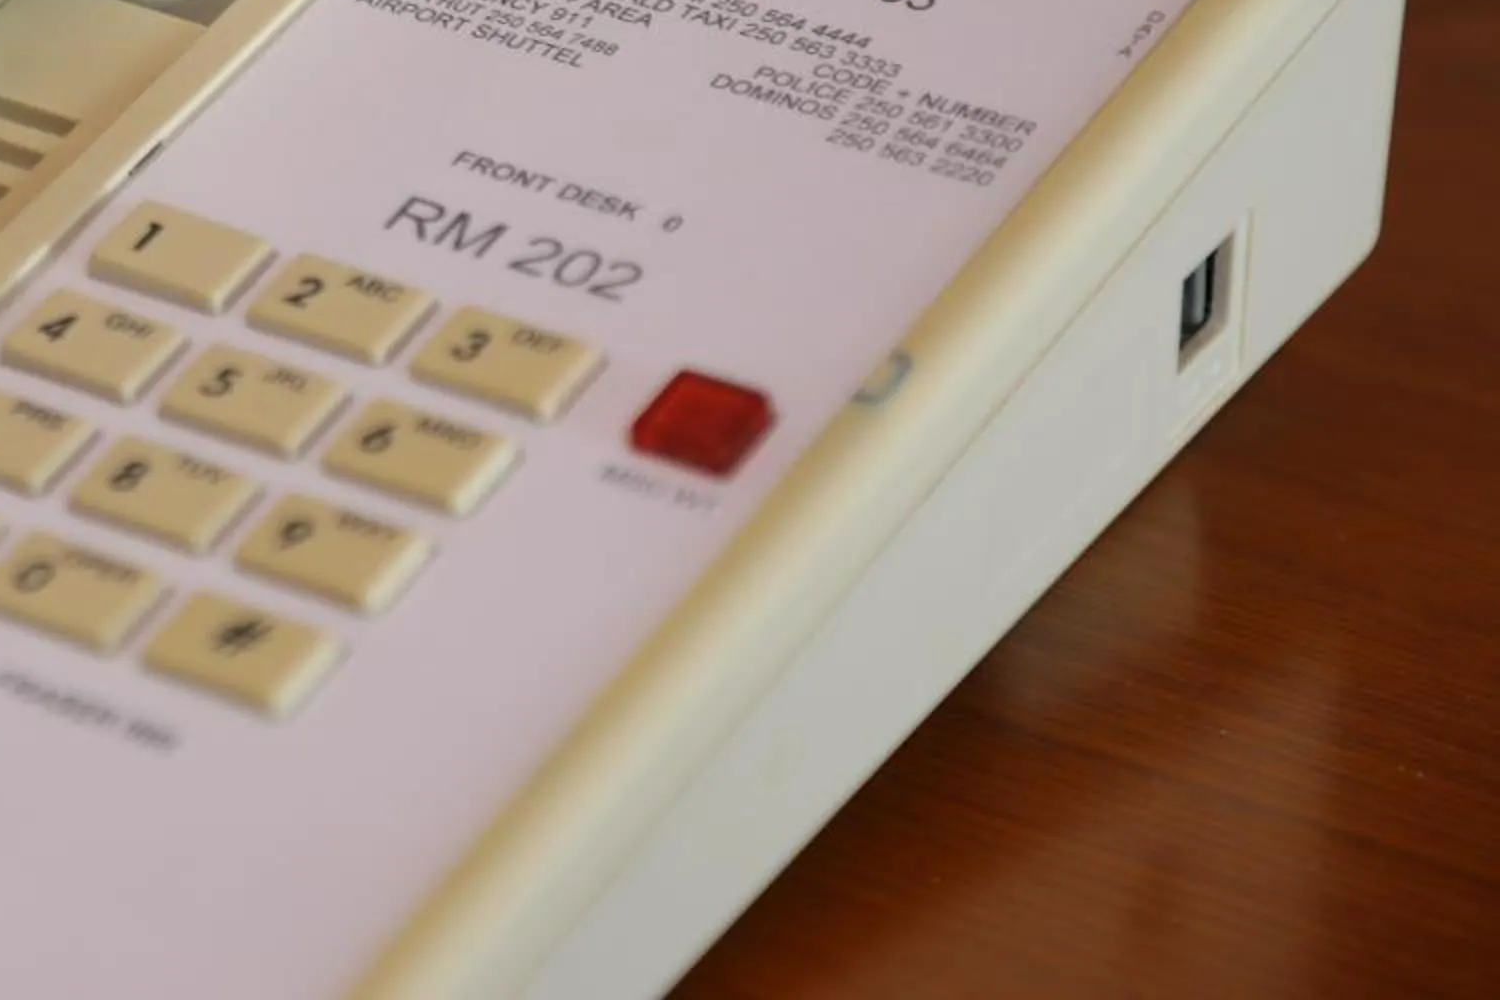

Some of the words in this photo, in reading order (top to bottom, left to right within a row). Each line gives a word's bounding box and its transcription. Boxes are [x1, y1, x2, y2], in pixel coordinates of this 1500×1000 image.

[680, 4, 738, 31] TAXI
[739, 24, 787, 46] 250
[789, 37, 835, 60] 563
[841, 51, 903, 78] 3333
[761, 9, 806, 31] 564
[811, 24, 873, 49] 4444
[485, 9, 524, 28] 250
[526, 22, 563, 41] 564
[709, 74, 838, 121] DOMINOS
[840, 112, 890, 136] 250
[551, 7, 594, 28] 911
[753, 66, 853, 104] POLICE
[855, 96, 904, 119] 250
[959, 125, 1024, 153] 3300
[583, 0, 653, 28] AREA
[812, 64, 893, 96] CODE
[916, 92, 1038, 136] NUMBER
[471, 24, 584, 68] SHUTTEL
[825, 128, 875, 152] 250
[451, 150, 555, 193] FRONT
[557, 183, 645, 221] DESK
[132, 221, 164, 252] 1
[383, 195, 509, 259] RM
[507, 237, 644, 303] 202
[281, 276, 325, 309] 2
[345, 275, 406, 304] ABC
[37, 313, 78, 342] 4
[449, 330, 493, 363] 3
[198, 367, 244, 397] 5
[359, 424, 398, 454] 6
[107, 461, 151, 493] 8
[280, 520, 314, 550] 9
[12, 562, 56, 593] 0
